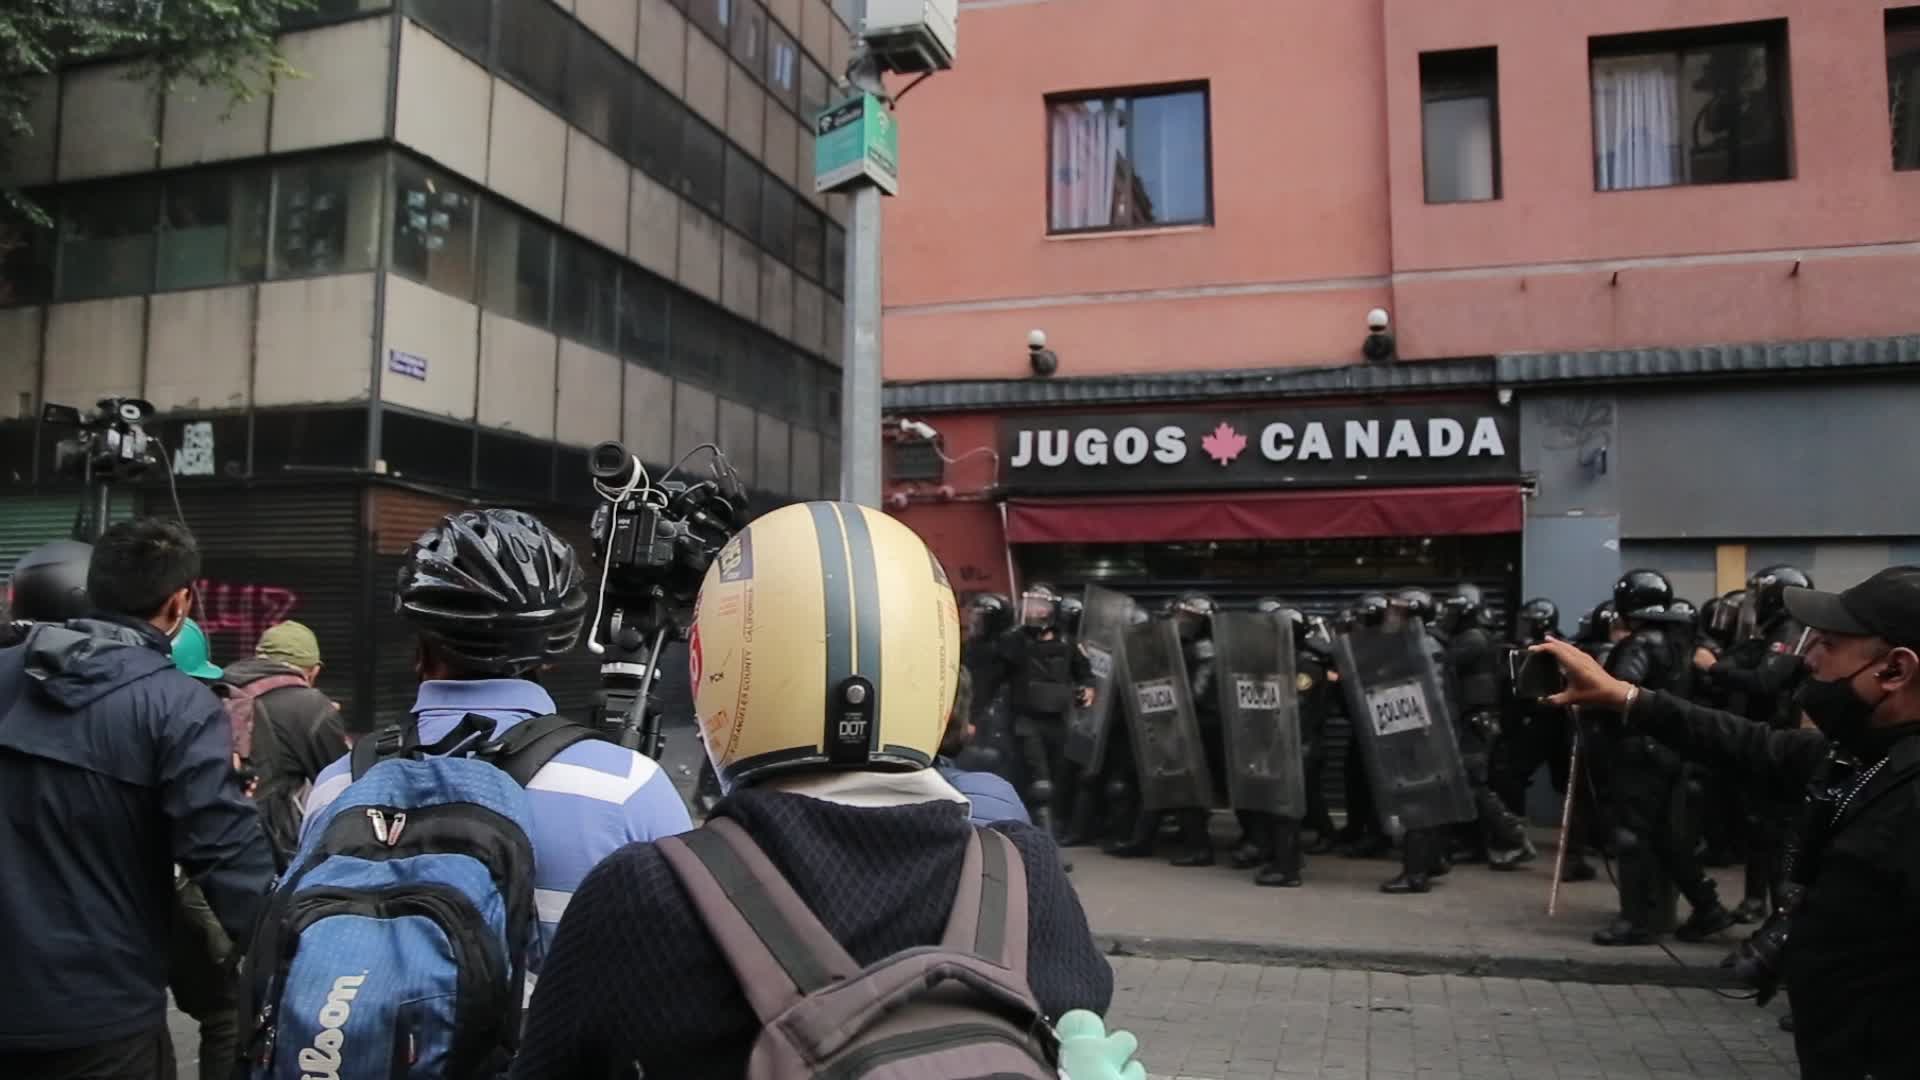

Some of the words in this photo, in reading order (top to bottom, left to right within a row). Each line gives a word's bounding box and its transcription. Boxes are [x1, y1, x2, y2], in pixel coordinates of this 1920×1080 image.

[1011, 426, 1187, 467] JUGOS
[1260, 417, 1505, 461] CANADA
[840, 721, 867, 736] DOT
[299, 975, 366, 1080] lson
